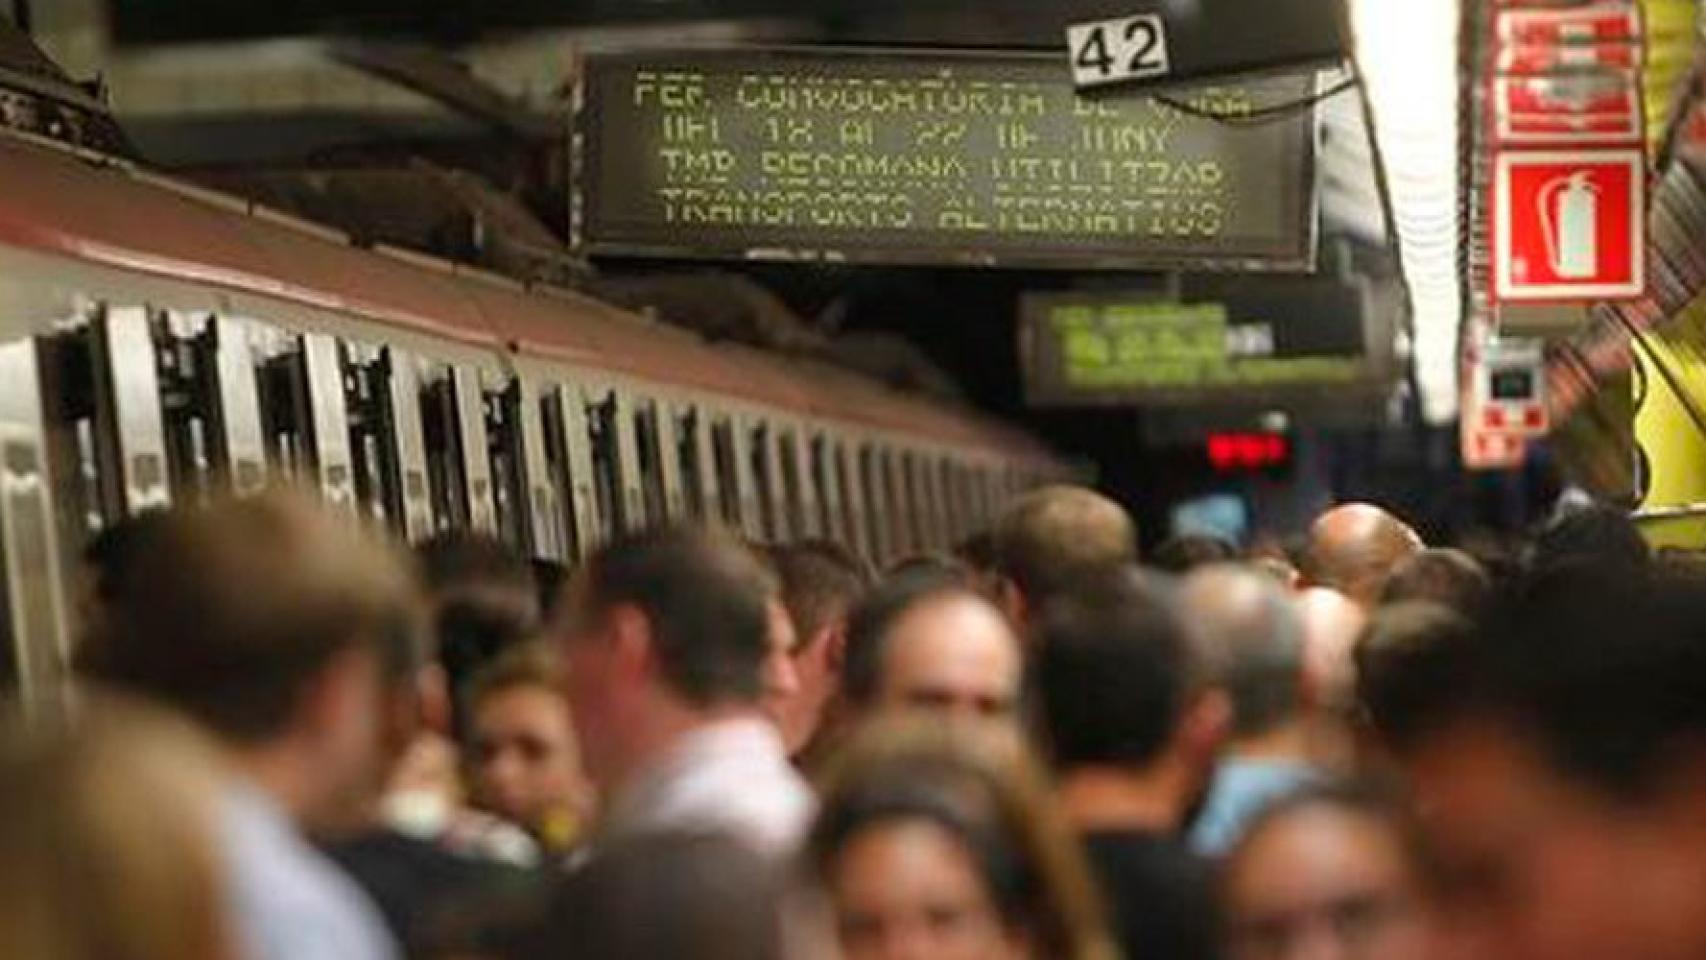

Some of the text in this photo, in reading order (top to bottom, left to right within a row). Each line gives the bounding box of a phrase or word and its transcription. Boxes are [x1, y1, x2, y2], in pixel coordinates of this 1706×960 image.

[1076, 20, 1161, 75] 42
[1070, 125, 1174, 154] JUNY
[760, 151, 967, 190] RECOMANA
[992, 157, 1223, 195] UTILITZAR
[655, 187, 1222, 236] TRANSPORTS ALTERNATIUS
